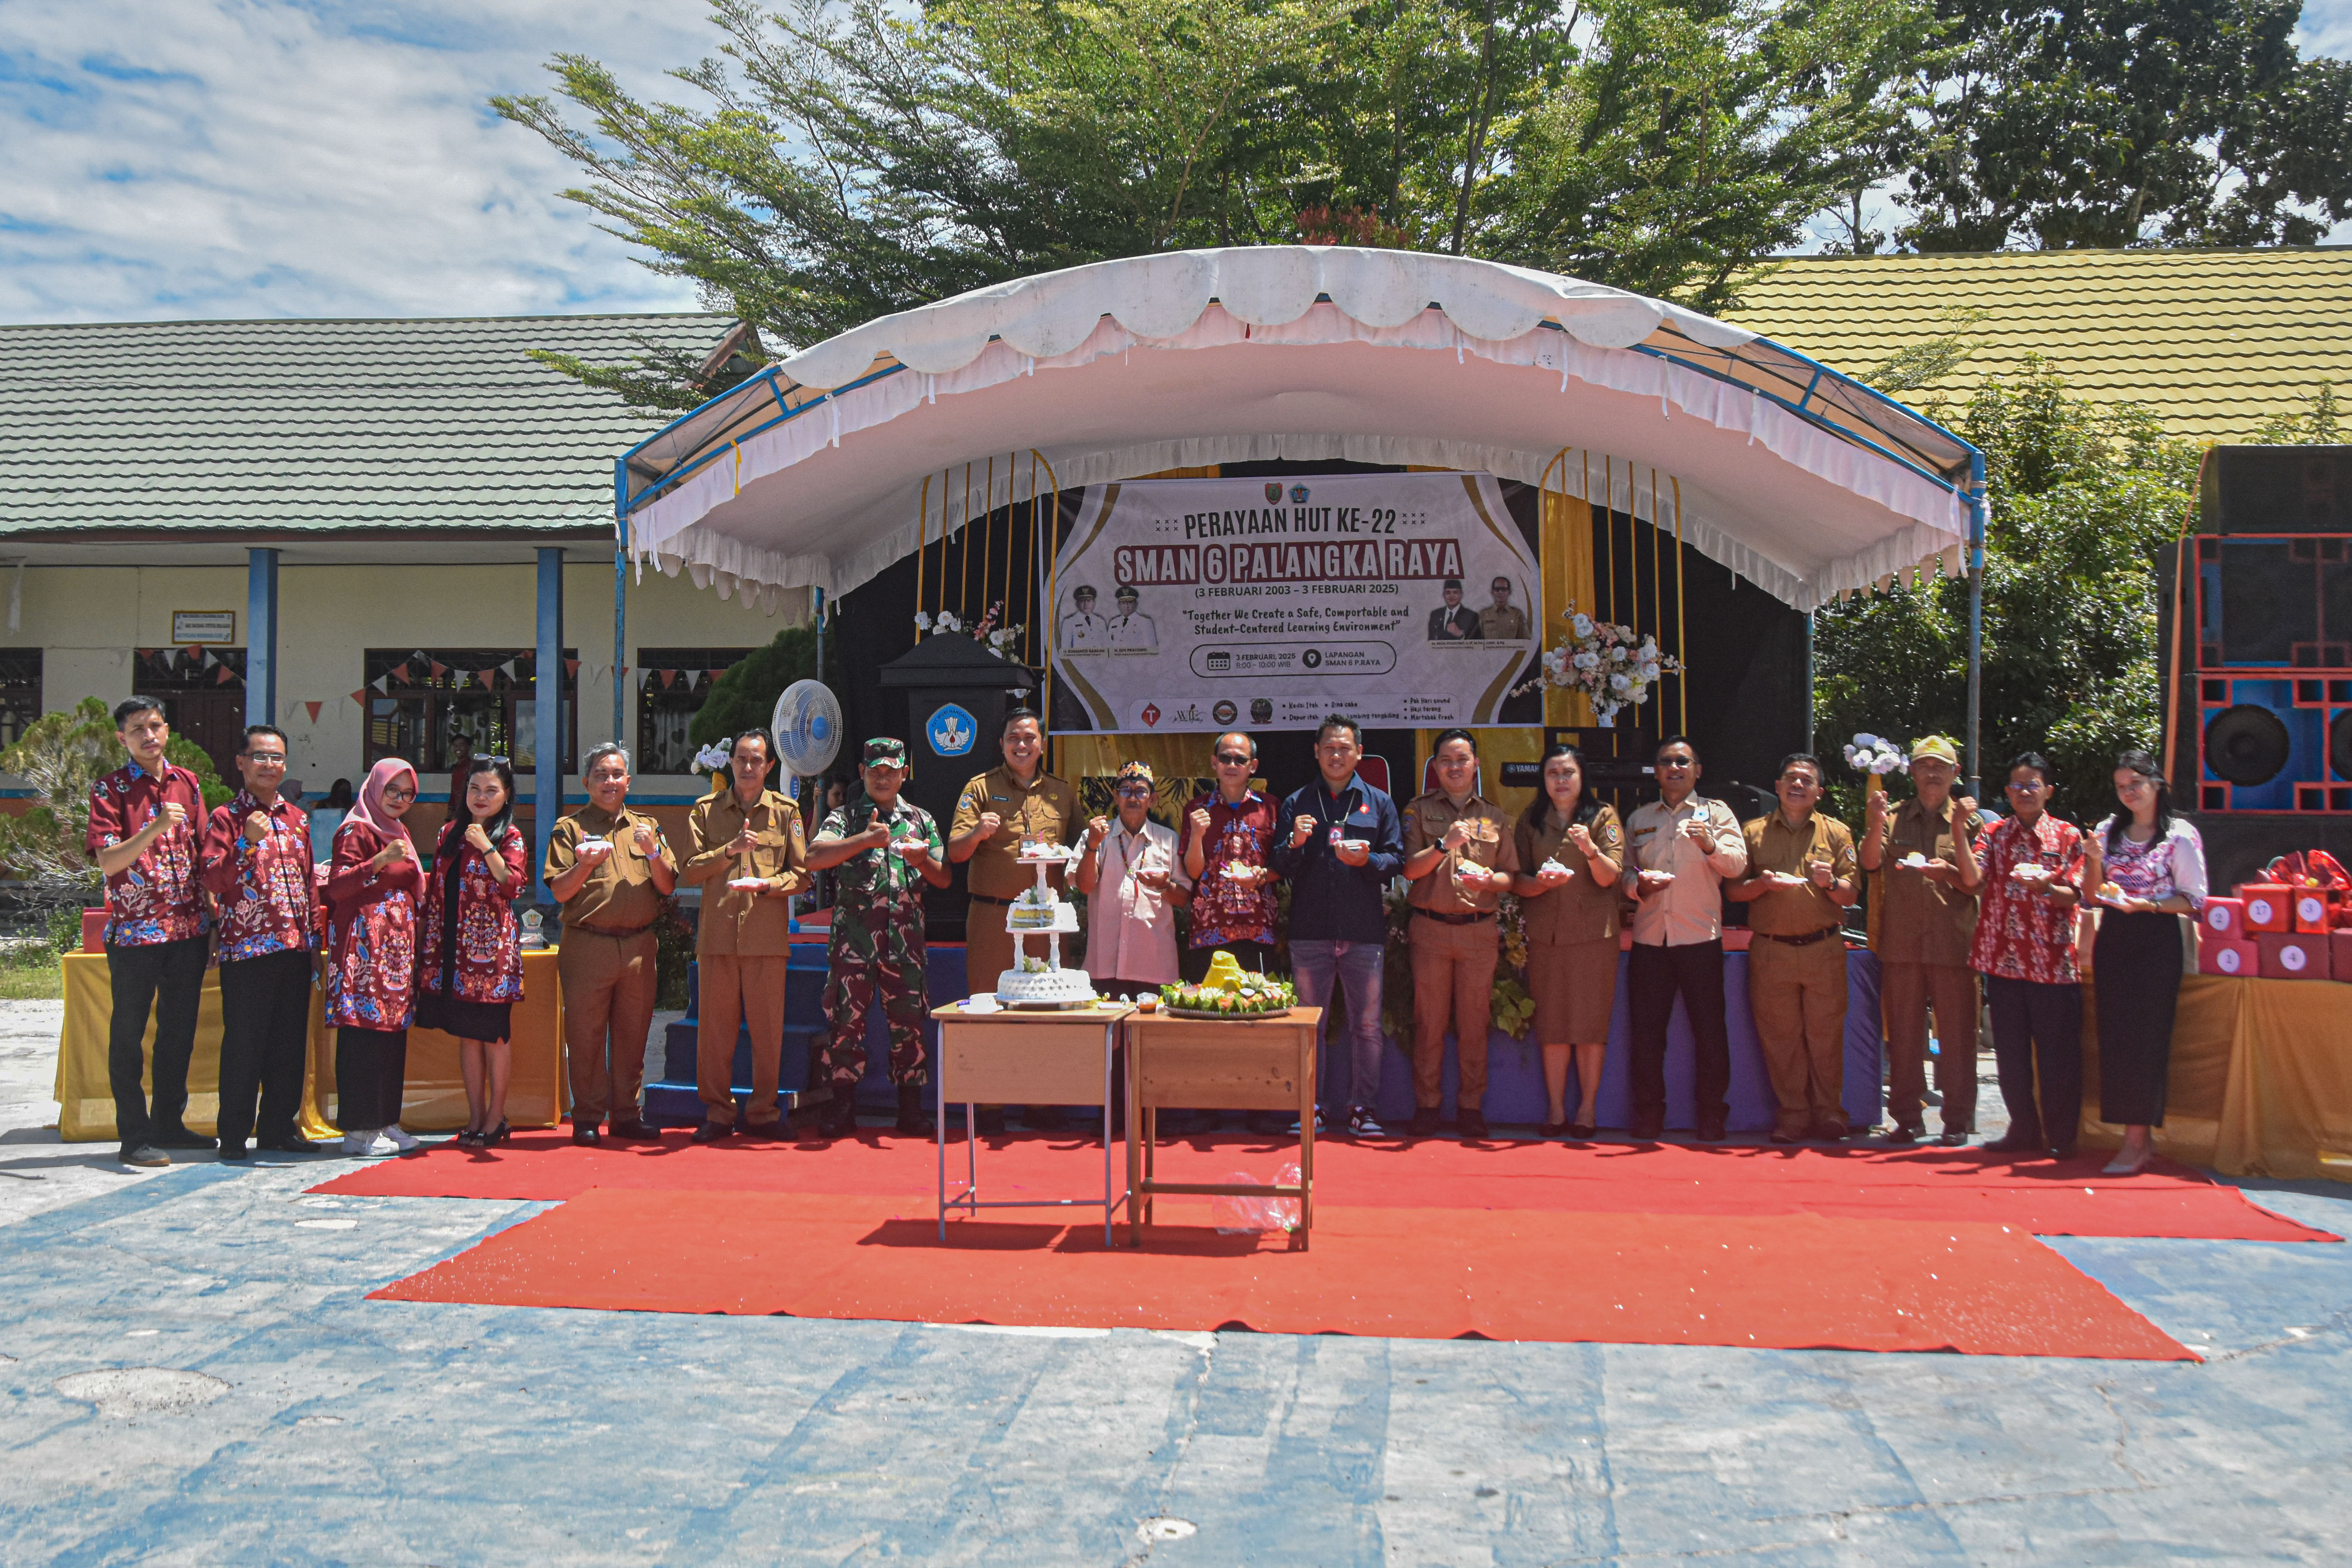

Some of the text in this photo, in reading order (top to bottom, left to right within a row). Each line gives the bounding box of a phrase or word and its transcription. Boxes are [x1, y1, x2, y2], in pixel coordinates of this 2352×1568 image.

[1184, 507, 1396, 539] PERAYAAN HUT KE-22
[1117, 542, 1461, 583] SMAN 6 PALANGKA RAYA
[1195, 588, 1205, 598] (3
[1209, 587, 1262, 597] FEBRUARI
[1265, 586, 1291, 595] 2003
[1302, 585, 1308, 594] 3
[1312, 584, 1366, 594] FEBRUARI
[1370, 584, 1399, 595] 2025)
[1234, 609, 1249, 619] We
[1252, 608, 1285, 619] Create
[1297, 607, 1322, 619] Safe,
[1325, 606, 1387, 620] Comportable
[1391, 606, 1409, 617] and
[1195, 622, 1284, 635] Student-Centered
[1288, 622, 1330, 634] Learning
[938, 710, 949, 719] WURI
[949, 709, 972, 726] HANDAYANI
[2255, 905, 2267, 915] 17
[2305, 903, 2313, 913] 3
